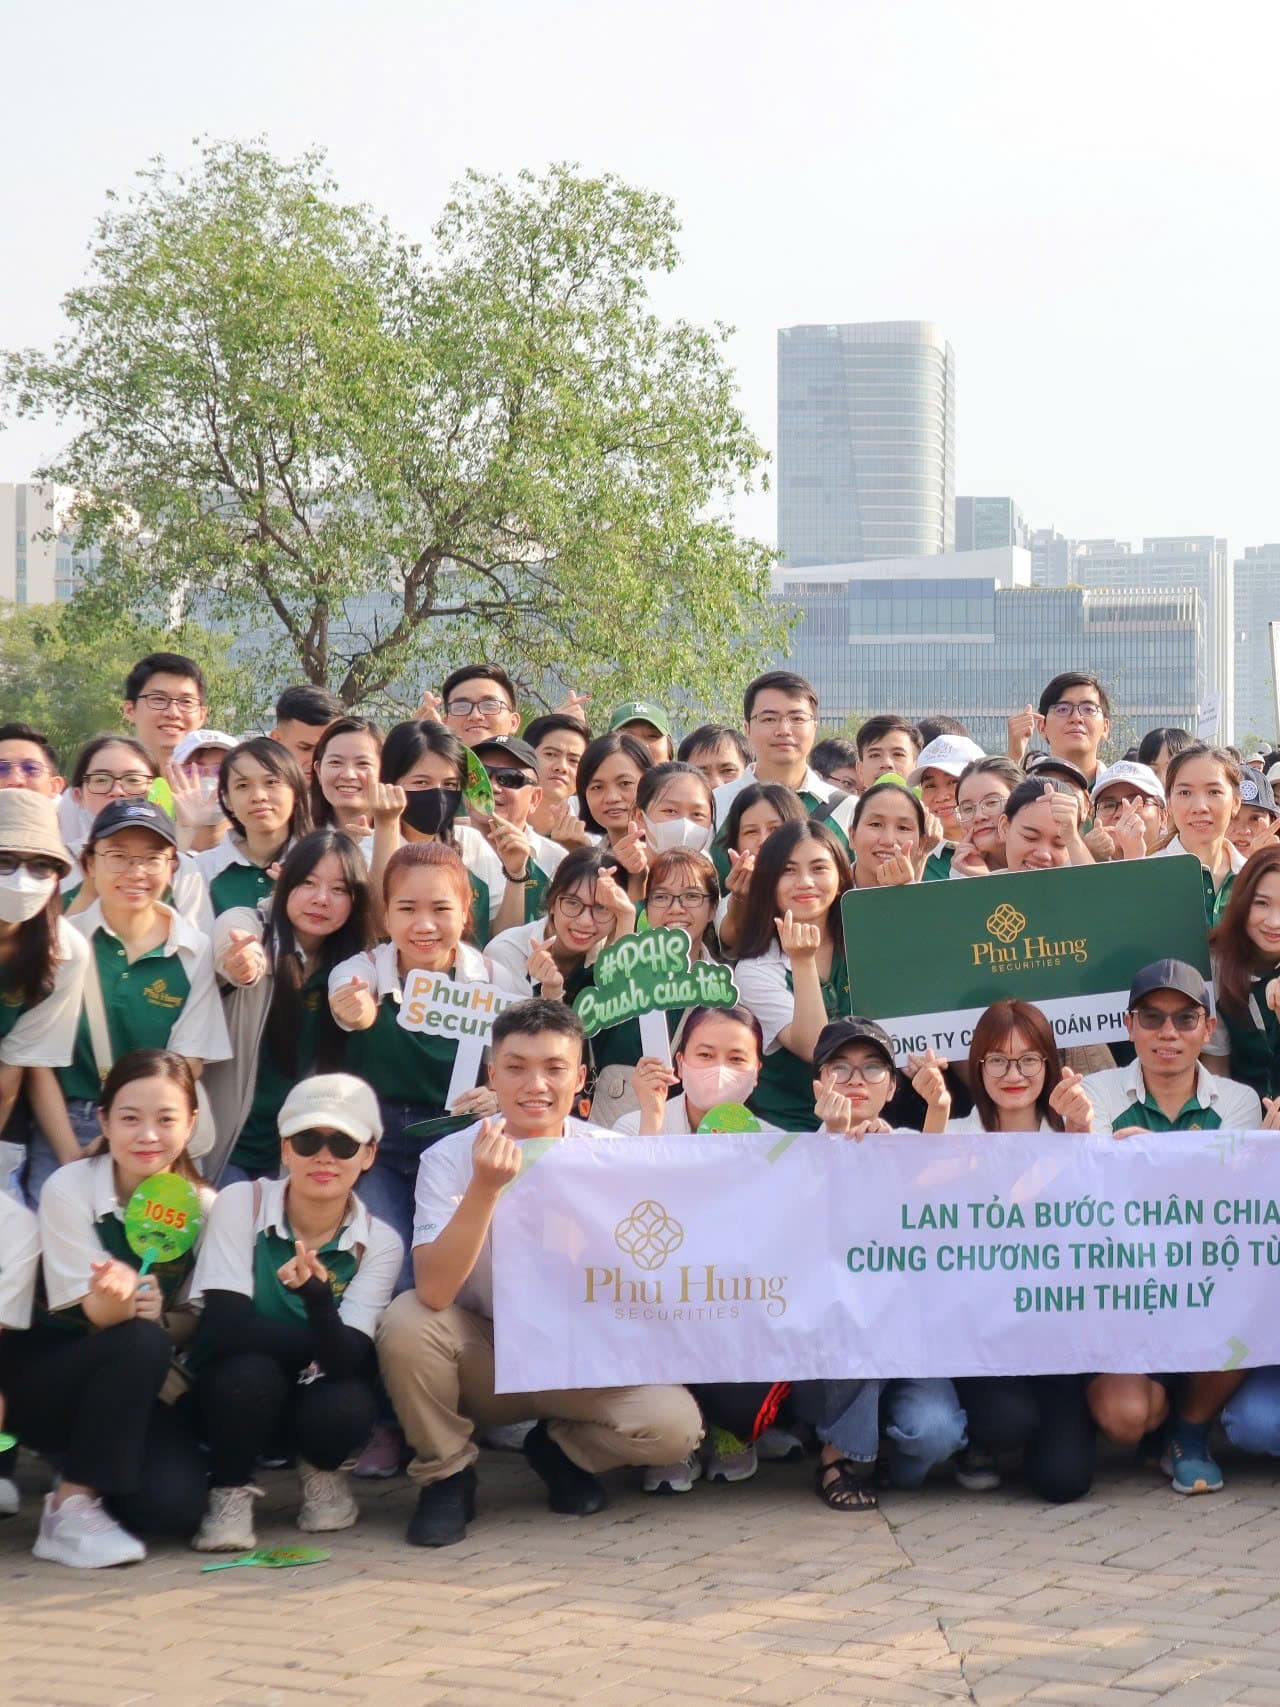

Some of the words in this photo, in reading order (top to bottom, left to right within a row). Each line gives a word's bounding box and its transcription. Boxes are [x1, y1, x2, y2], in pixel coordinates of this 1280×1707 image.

[600, 934, 684, 985] #PHS
[971, 942, 1016, 966] Phu
[1023, 936, 1088, 963] Hung
[992, 958, 1062, 973] SECURITIES
[578, 978, 650, 1031] Crush
[653, 971, 697, 1004] của
[696, 967, 733, 1003] tôi
[932, 1031, 955, 1050] TY
[144, 1199, 187, 1229] 1055
[902, 1203, 958, 1229] LAN
[967, 1195, 1025, 1229] TỎA
[1035, 1196, 1115, 1227] BƯỚC
[1125, 1193, 1203, 1226] CHÂN
[847, 1240, 926, 1272] CÙNG
[936, 1242, 1060, 1272] CHƯƠNG
[1068, 1237, 1156, 1270] TRÌNH
[1164, 1241, 1192, 1268] ĐI
[1202, 1234, 1240, 1272] BỘ
[580, 1266, 663, 1304] Phu
[678, 1264, 788, 1317] Hung
[1014, 1285, 1084, 1313] ĐINH
[1093, 1278, 1177, 1315] THIỆN
[1187, 1276, 1215, 1308] LÝ
[615, 1306, 740, 1321] SECURITIES
